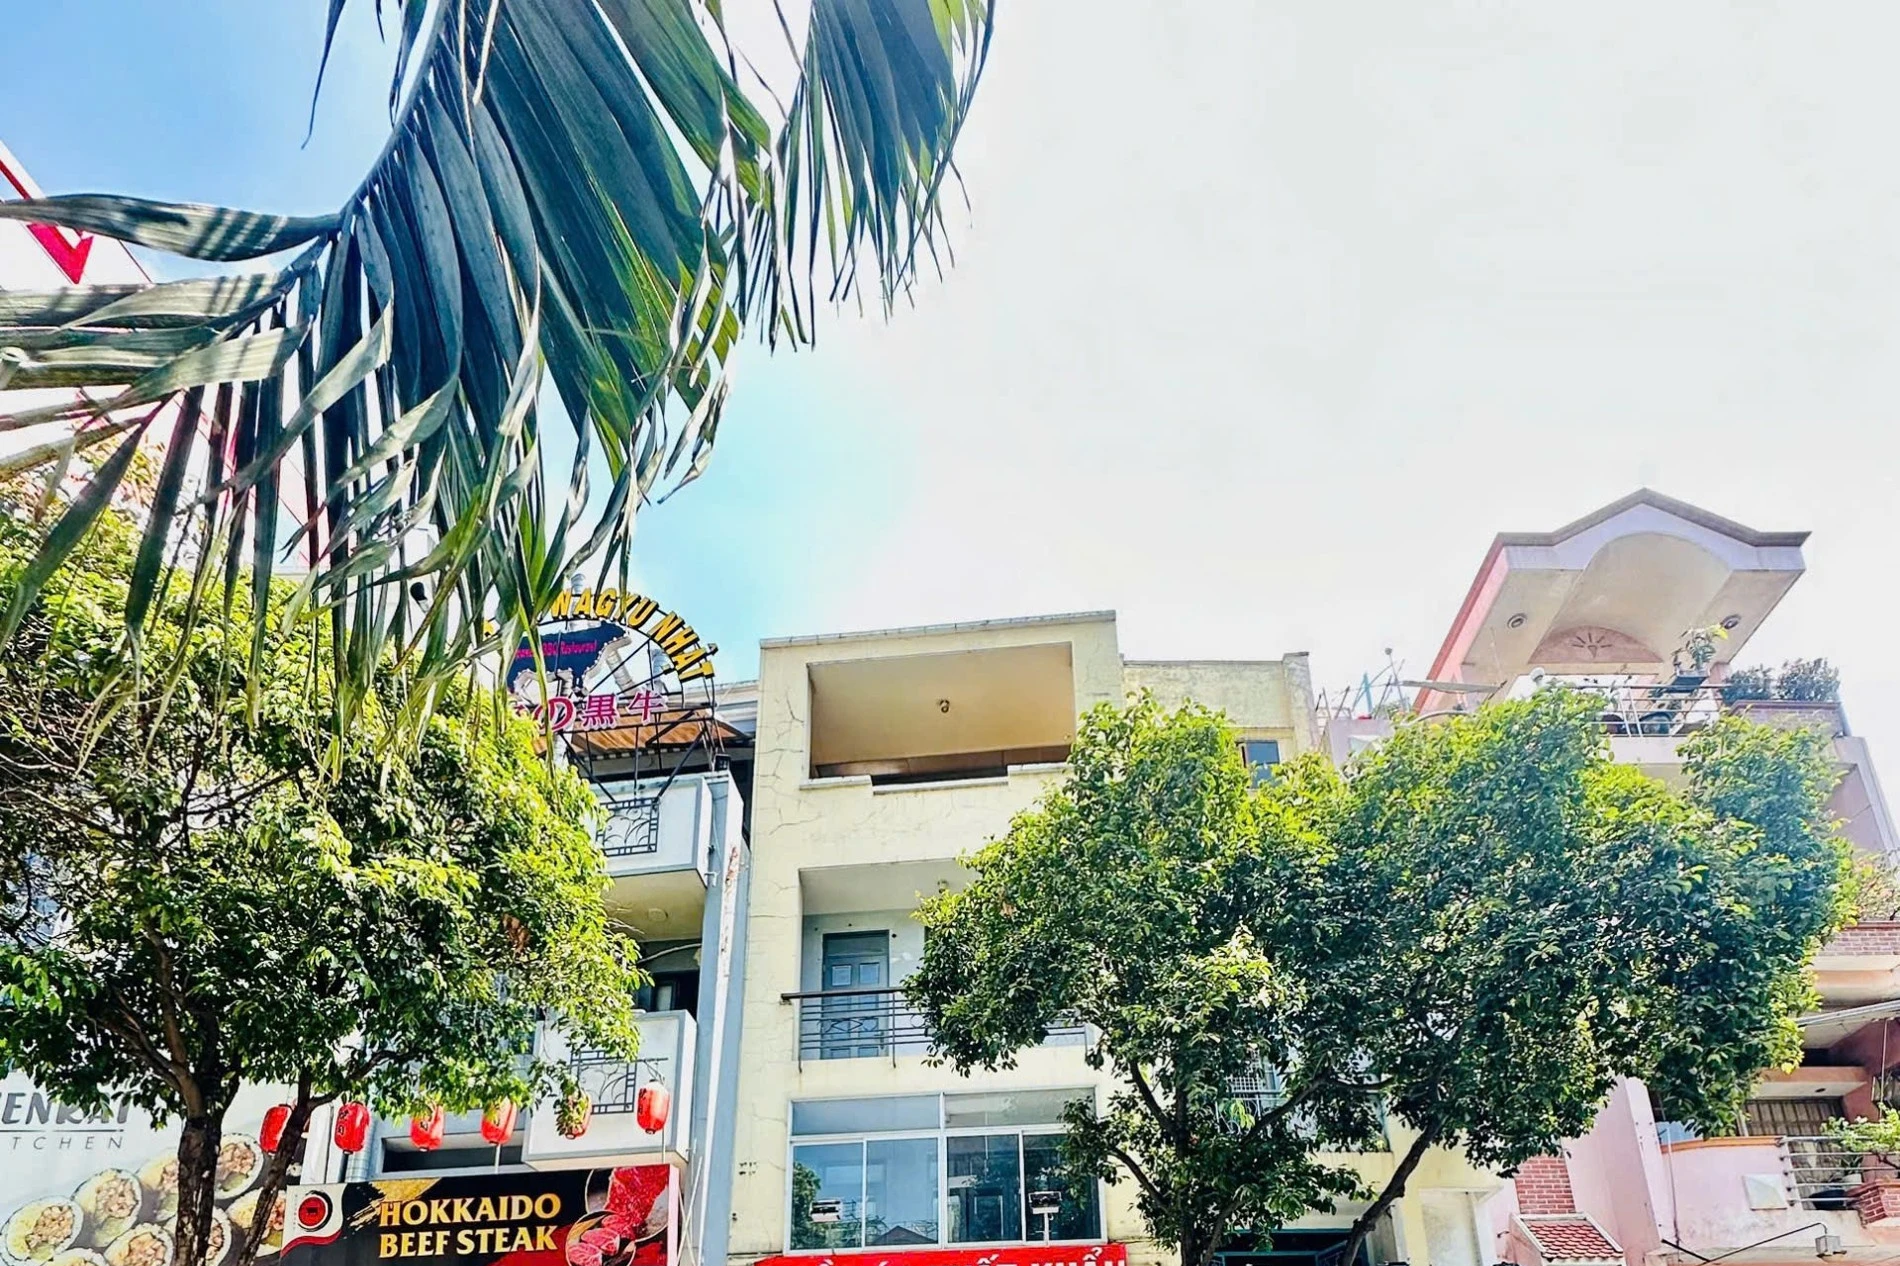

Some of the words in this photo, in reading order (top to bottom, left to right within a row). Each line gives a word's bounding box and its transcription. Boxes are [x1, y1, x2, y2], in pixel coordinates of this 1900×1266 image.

[510, 689, 668, 732] の黒牛
[379, 1193, 562, 1228] HOKKAIDO
[379, 1230, 450, 1259] BEEF
[456, 1225, 559, 1254] STEAK
